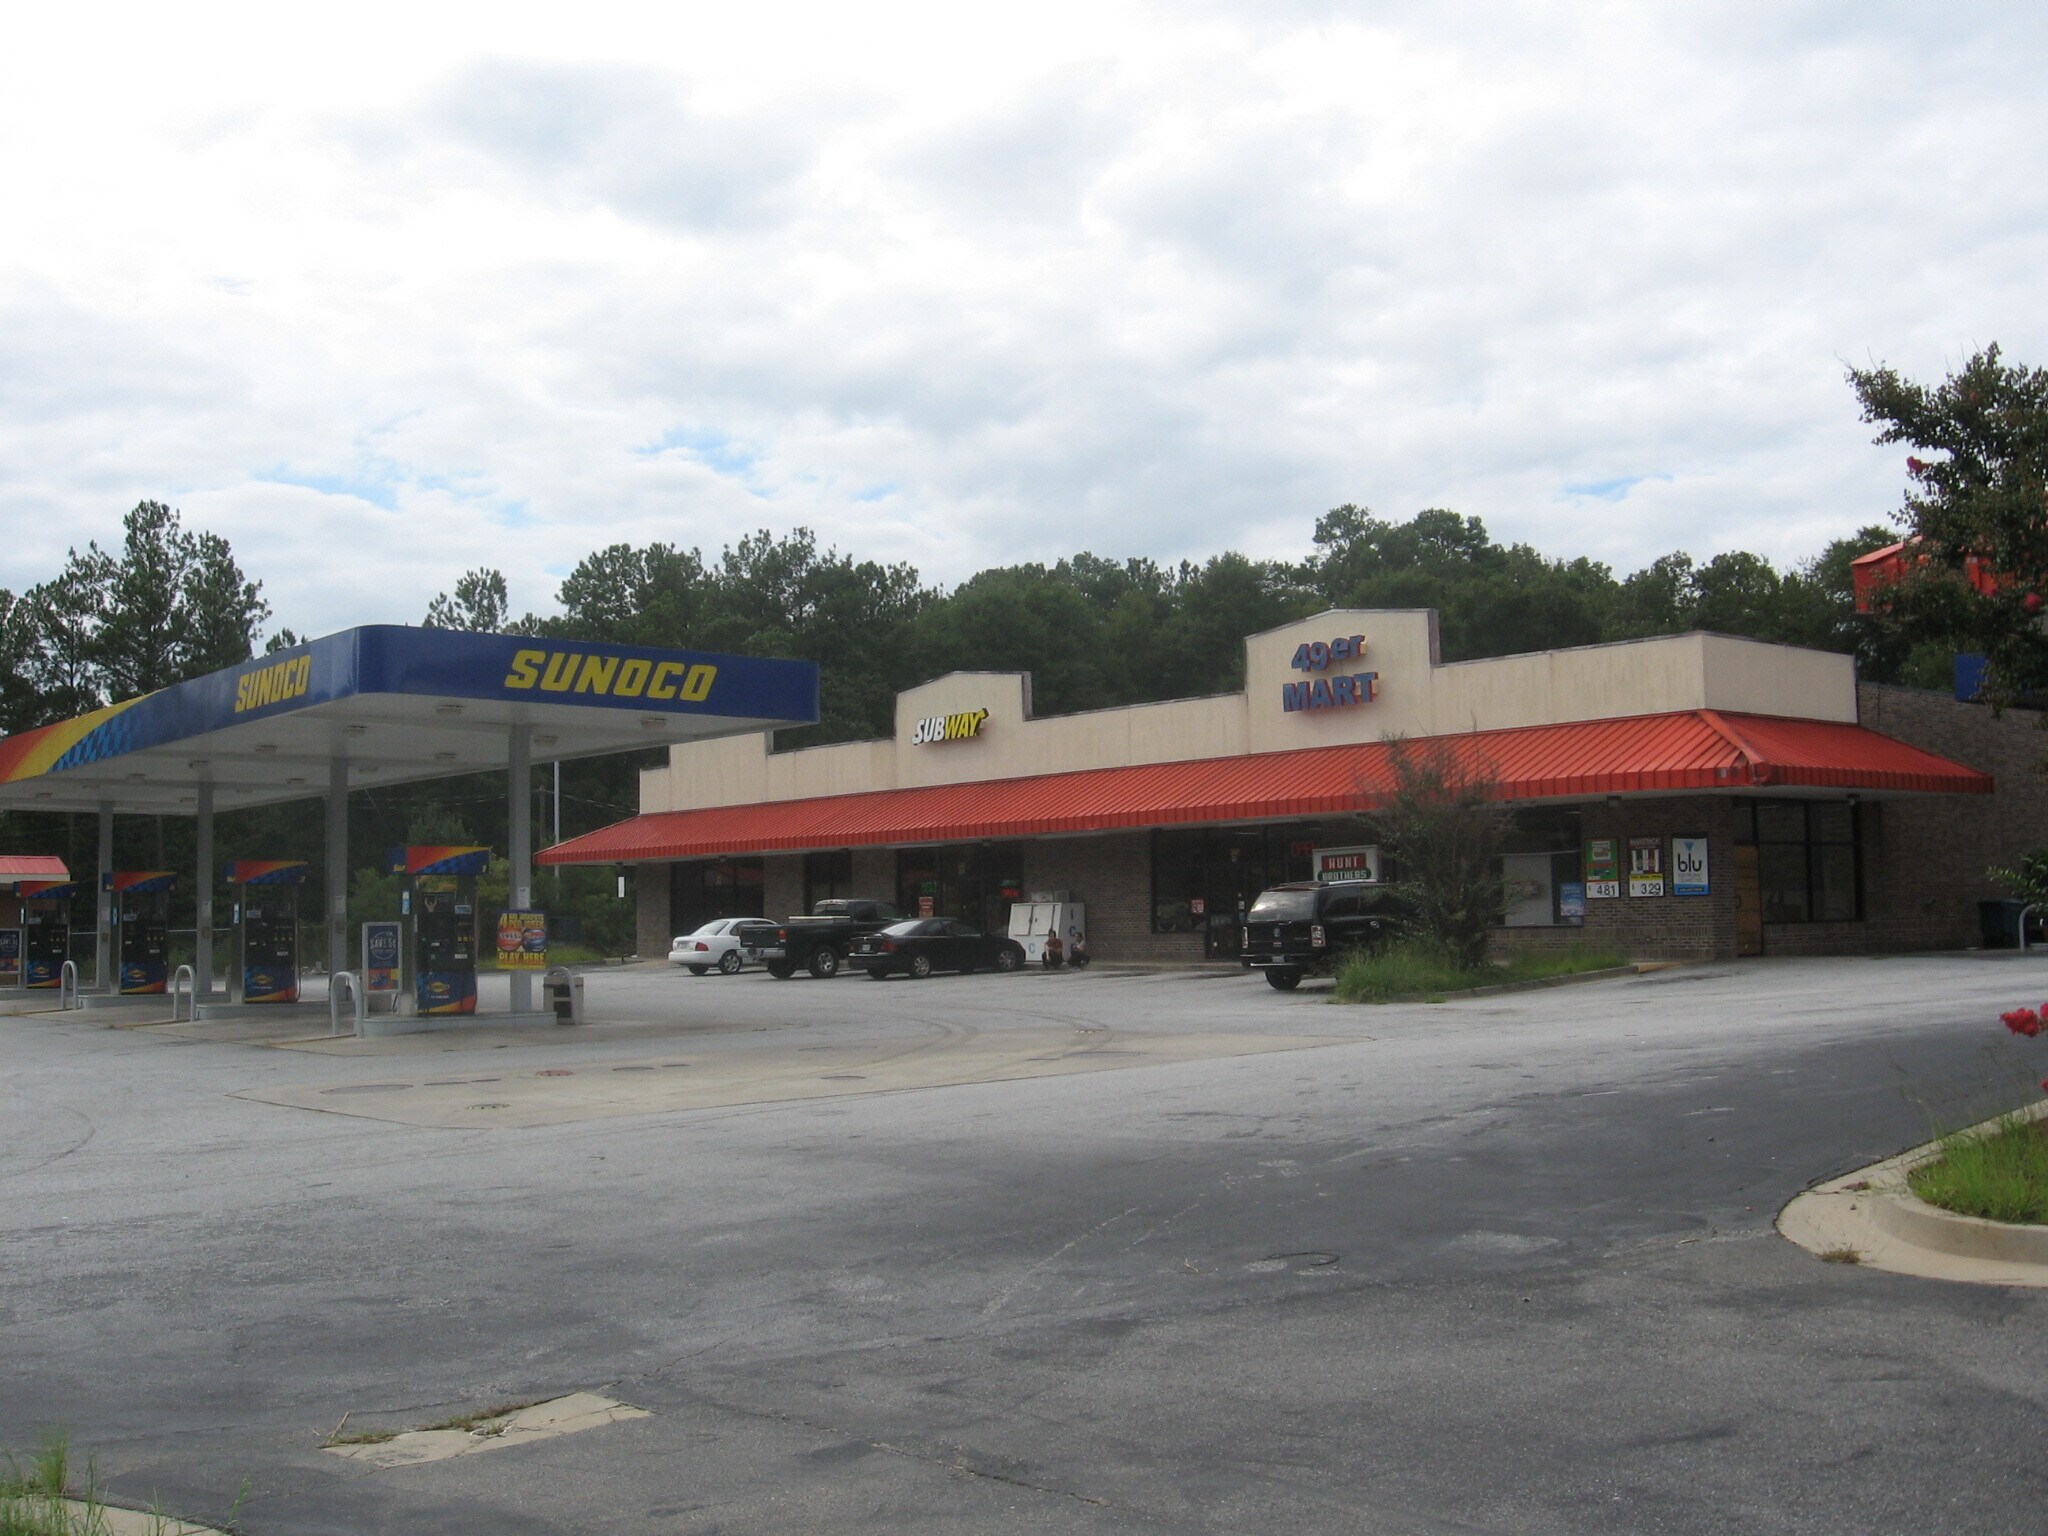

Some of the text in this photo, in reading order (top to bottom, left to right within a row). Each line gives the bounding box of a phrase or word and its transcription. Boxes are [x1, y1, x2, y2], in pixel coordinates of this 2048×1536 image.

[1291, 634, 1366, 672] 49er
[235, 655, 311, 713] SUNOCO
[504, 649, 718, 702] SUNOCO
[1282, 671, 1379, 712] MART
[911, 707, 989, 746] SUBWAY
[1328, 856, 1359, 869] HUNT
[1677, 852, 1702, 872] blu
[1322, 869, 1367, 880] BROTHERS
[1596, 884, 1616, 896] 481
[1640, 882, 1661, 894] 329
[498, 952, 545, 965] PLAY HERE
